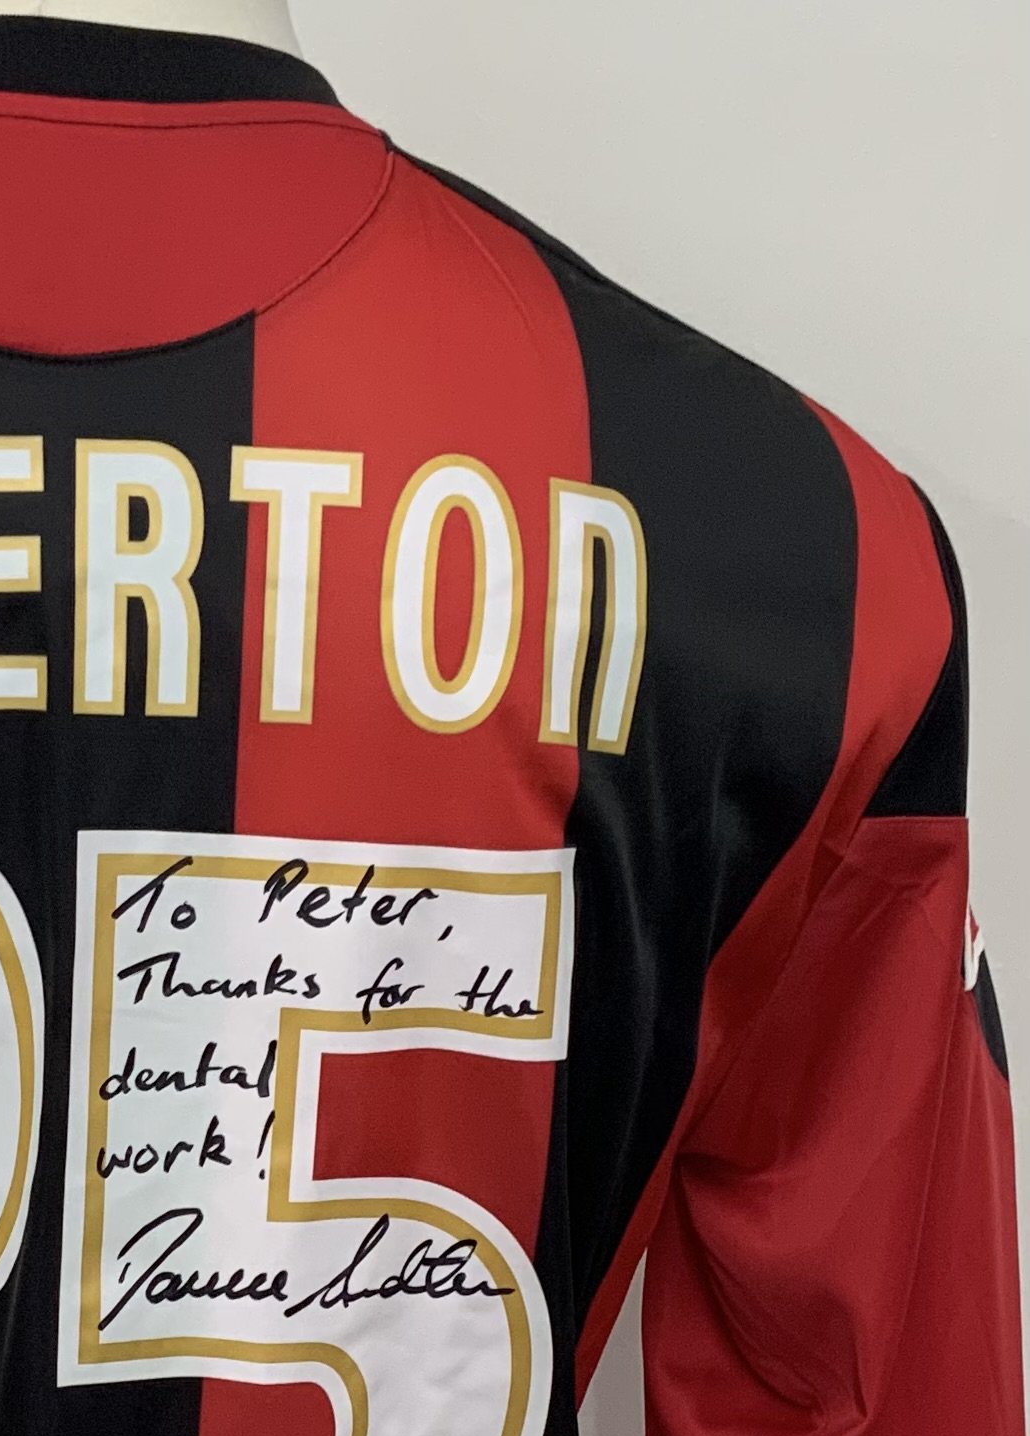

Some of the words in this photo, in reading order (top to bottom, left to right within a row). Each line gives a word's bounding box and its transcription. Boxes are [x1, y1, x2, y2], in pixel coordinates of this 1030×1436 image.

[111, 856, 196, 933] To
[258, 858, 454, 941] Peter,
[117, 952, 321, 1005] Thanks
[356, 957, 424, 1024] for
[455, 965, 545, 1019] the
[98, 1040, 278, 1101] dental
